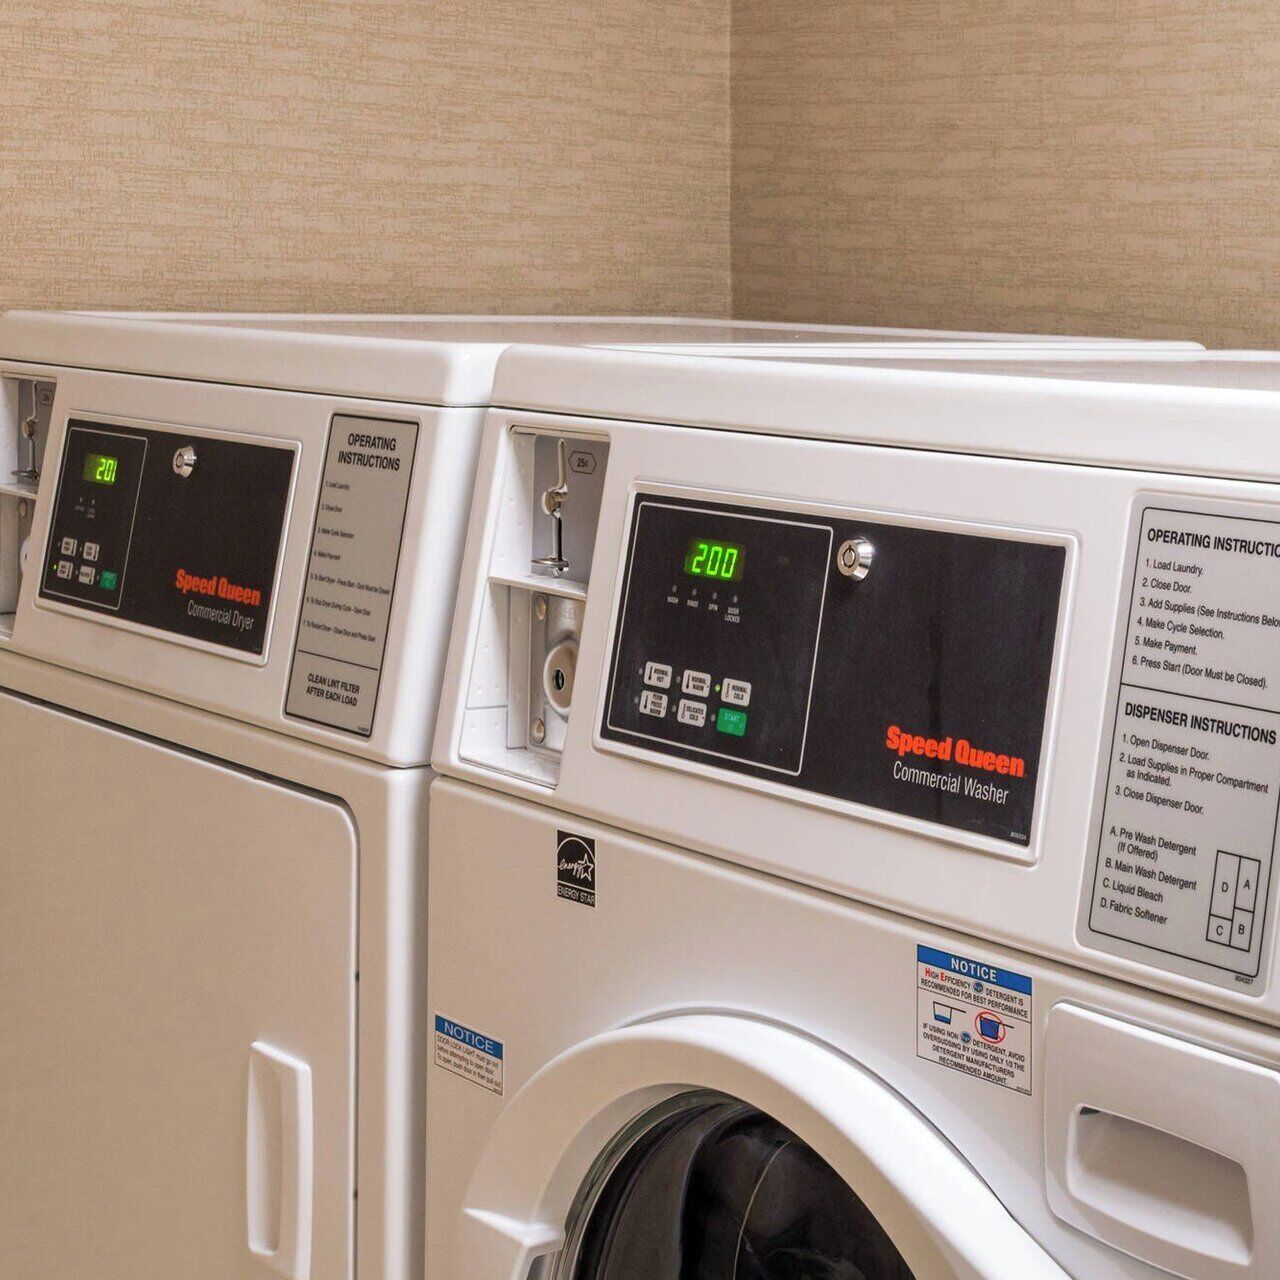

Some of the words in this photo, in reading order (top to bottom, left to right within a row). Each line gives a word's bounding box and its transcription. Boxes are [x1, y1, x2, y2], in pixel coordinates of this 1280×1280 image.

[348, 433, 396, 451] OPERATING
[338, 451, 400, 471] INSTRUCTIONS
[1148, 528, 1210, 548] OPERATING
[692, 544, 738, 578] 200
[1146, 558, 1151, 568] 1.
[1153, 559, 1172, 570] Load
[1173, 562, 1204, 578] Laundry.
[176, 568, 217, 595] Speed
[218, 577, 260, 606] Queen
[1150, 578, 1172, 591] Close
[1173, 581, 1192, 594] Door.
[188, 600, 232, 624] Commercial
[232, 610, 254, 632] Dryer
[725, 614, 740, 623] LOCKED
[1140, 597, 1146, 607] 3.
[1148, 598, 1162, 609] Add
[1164, 600, 1196, 614] Supplies
[1197, 605, 1214, 618] (See
[1216, 608, 1260, 624] Instructions
[1136, 616, 1144, 626] 4.
[1146, 617, 1164, 630] Make
[1166, 620, 1188, 634] Cycle
[1189, 624, 1224, 639] Selection.
[1143, 637, 1162, 649] Make
[1164, 640, 1197, 655] Payment.
[308, 673, 326, 686] CLEAN
[327, 678, 340, 690] LINT
[340, 682, 360, 694] FILTER
[1132, 655, 1138, 666] 6.
[1140, 656, 1161, 669] Press
[1162, 660, 1181, 672] Start
[1182, 663, 1204, 677] (Door
[1204, 668, 1223, 680] Must
[1224, 672, 1234, 682] be
[1236, 673, 1268, 690] Closed).
[306, 685, 324, 698] AFTER
[325, 690, 340, 702] EACH
[341, 695, 358, 706] LOAD
[1125, 702, 1188, 728] DISPENSER
[1190, 715, 1276, 745] INSTRUCTIONS
[886, 724, 952, 761] Speed
[955, 739, 1025, 778] Queen
[1123, 734, 1128, 744] 1.
[1130, 734, 1150, 748] Open
[1152, 738, 1188, 756] Dispenser
[1190, 746, 1210, 760] Door.
[893, 760, 960, 794] Commercial
[964, 776, 1010, 805] Washer
[1126, 769, 1136, 778] as
[1128, 754, 1146, 766] Load
[1148, 758, 1179, 774] Supplies
[1180, 765, 1188, 776] in
[1189, 767, 1214, 782] Proper
[1216, 772, 1268, 794] Compartment
[1123, 786, 1144, 800] Close
[1146, 792, 1182, 809] Dispenser
[1184, 800, 1204, 814] Door.
[1110, 826, 1118, 836] A.
[1120, 828, 1133, 840] Pre
[1134, 831, 1156, 846] Wash
[1158, 837, 1196, 856] Detergent
[1118, 841, 1126, 854] (If
[1127, 844, 1158, 862] Offered)
[1105, 857, 1113, 868] B.
[1114, 860, 1133, 874] Main
[1135, 865, 1156, 880] Wash
[1158, 870, 1197, 890] Detergent
[1222, 882, 1228, 892] D
[1243, 880, 1250, 890] A
[1102, 877, 1110, 888] C.
[1112, 880, 1136, 895] Liquid
[1137, 886, 1164, 902] Bleach
[1100, 897, 1108, 908] D.
[1110, 900, 1133, 916] Fabric
[1134, 906, 1168, 924] Softener
[1216, 926, 1224, 936] C
[1238, 924, 1245, 934] B
[950, 958, 997, 982] NOTICE
[921, 978, 960, 997] RECOMMENDED
[961, 990, 972, 1000] FOR
[973, 994, 986, 1005] BEST
[988, 998, 1028, 1018] PERFORMANCE
[986, 987, 1017, 1004] DETERGENT
[1018, 998, 1024, 1006] IS
[444, 1021, 494, 1054] NOTICE
[928, 1024, 946, 1036] USING
[946, 1030, 959, 1040] NON
[972, 1040, 1007, 1057] DETERGENT,
[1008, 1050, 1025, 1062] AVOID
[922, 1032, 961, 1050] OVERSUDSING
[962, 1044, 970, 1053] BY
[971, 1048, 988, 1060] USING
[989, 1053, 1004, 1064] ONLY
[1014, 1062, 1024, 1072] THE
[932, 1044, 965, 1060] DETERGENT
[966, 1056, 1015, 1078] MANUFACTURERS
[939, 1055, 982, 1076] RECOMMENDED
